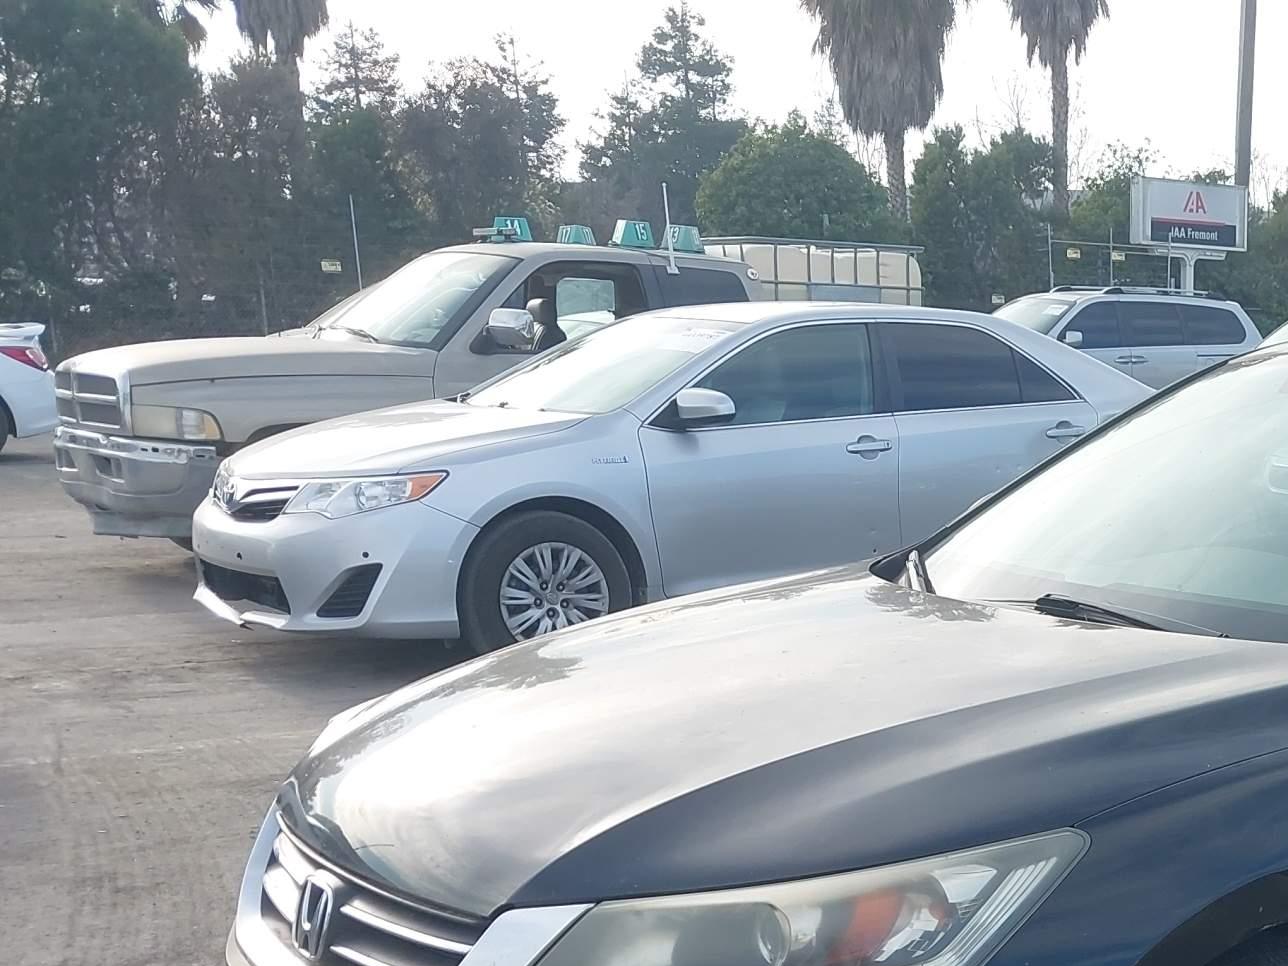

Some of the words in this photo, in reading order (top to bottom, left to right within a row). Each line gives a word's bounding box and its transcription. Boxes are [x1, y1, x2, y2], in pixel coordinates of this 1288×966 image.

[635, 223, 648, 241] 15
[1171, 226, 1187, 239] IAA
[1187, 228, 1218, 241] Fremont
